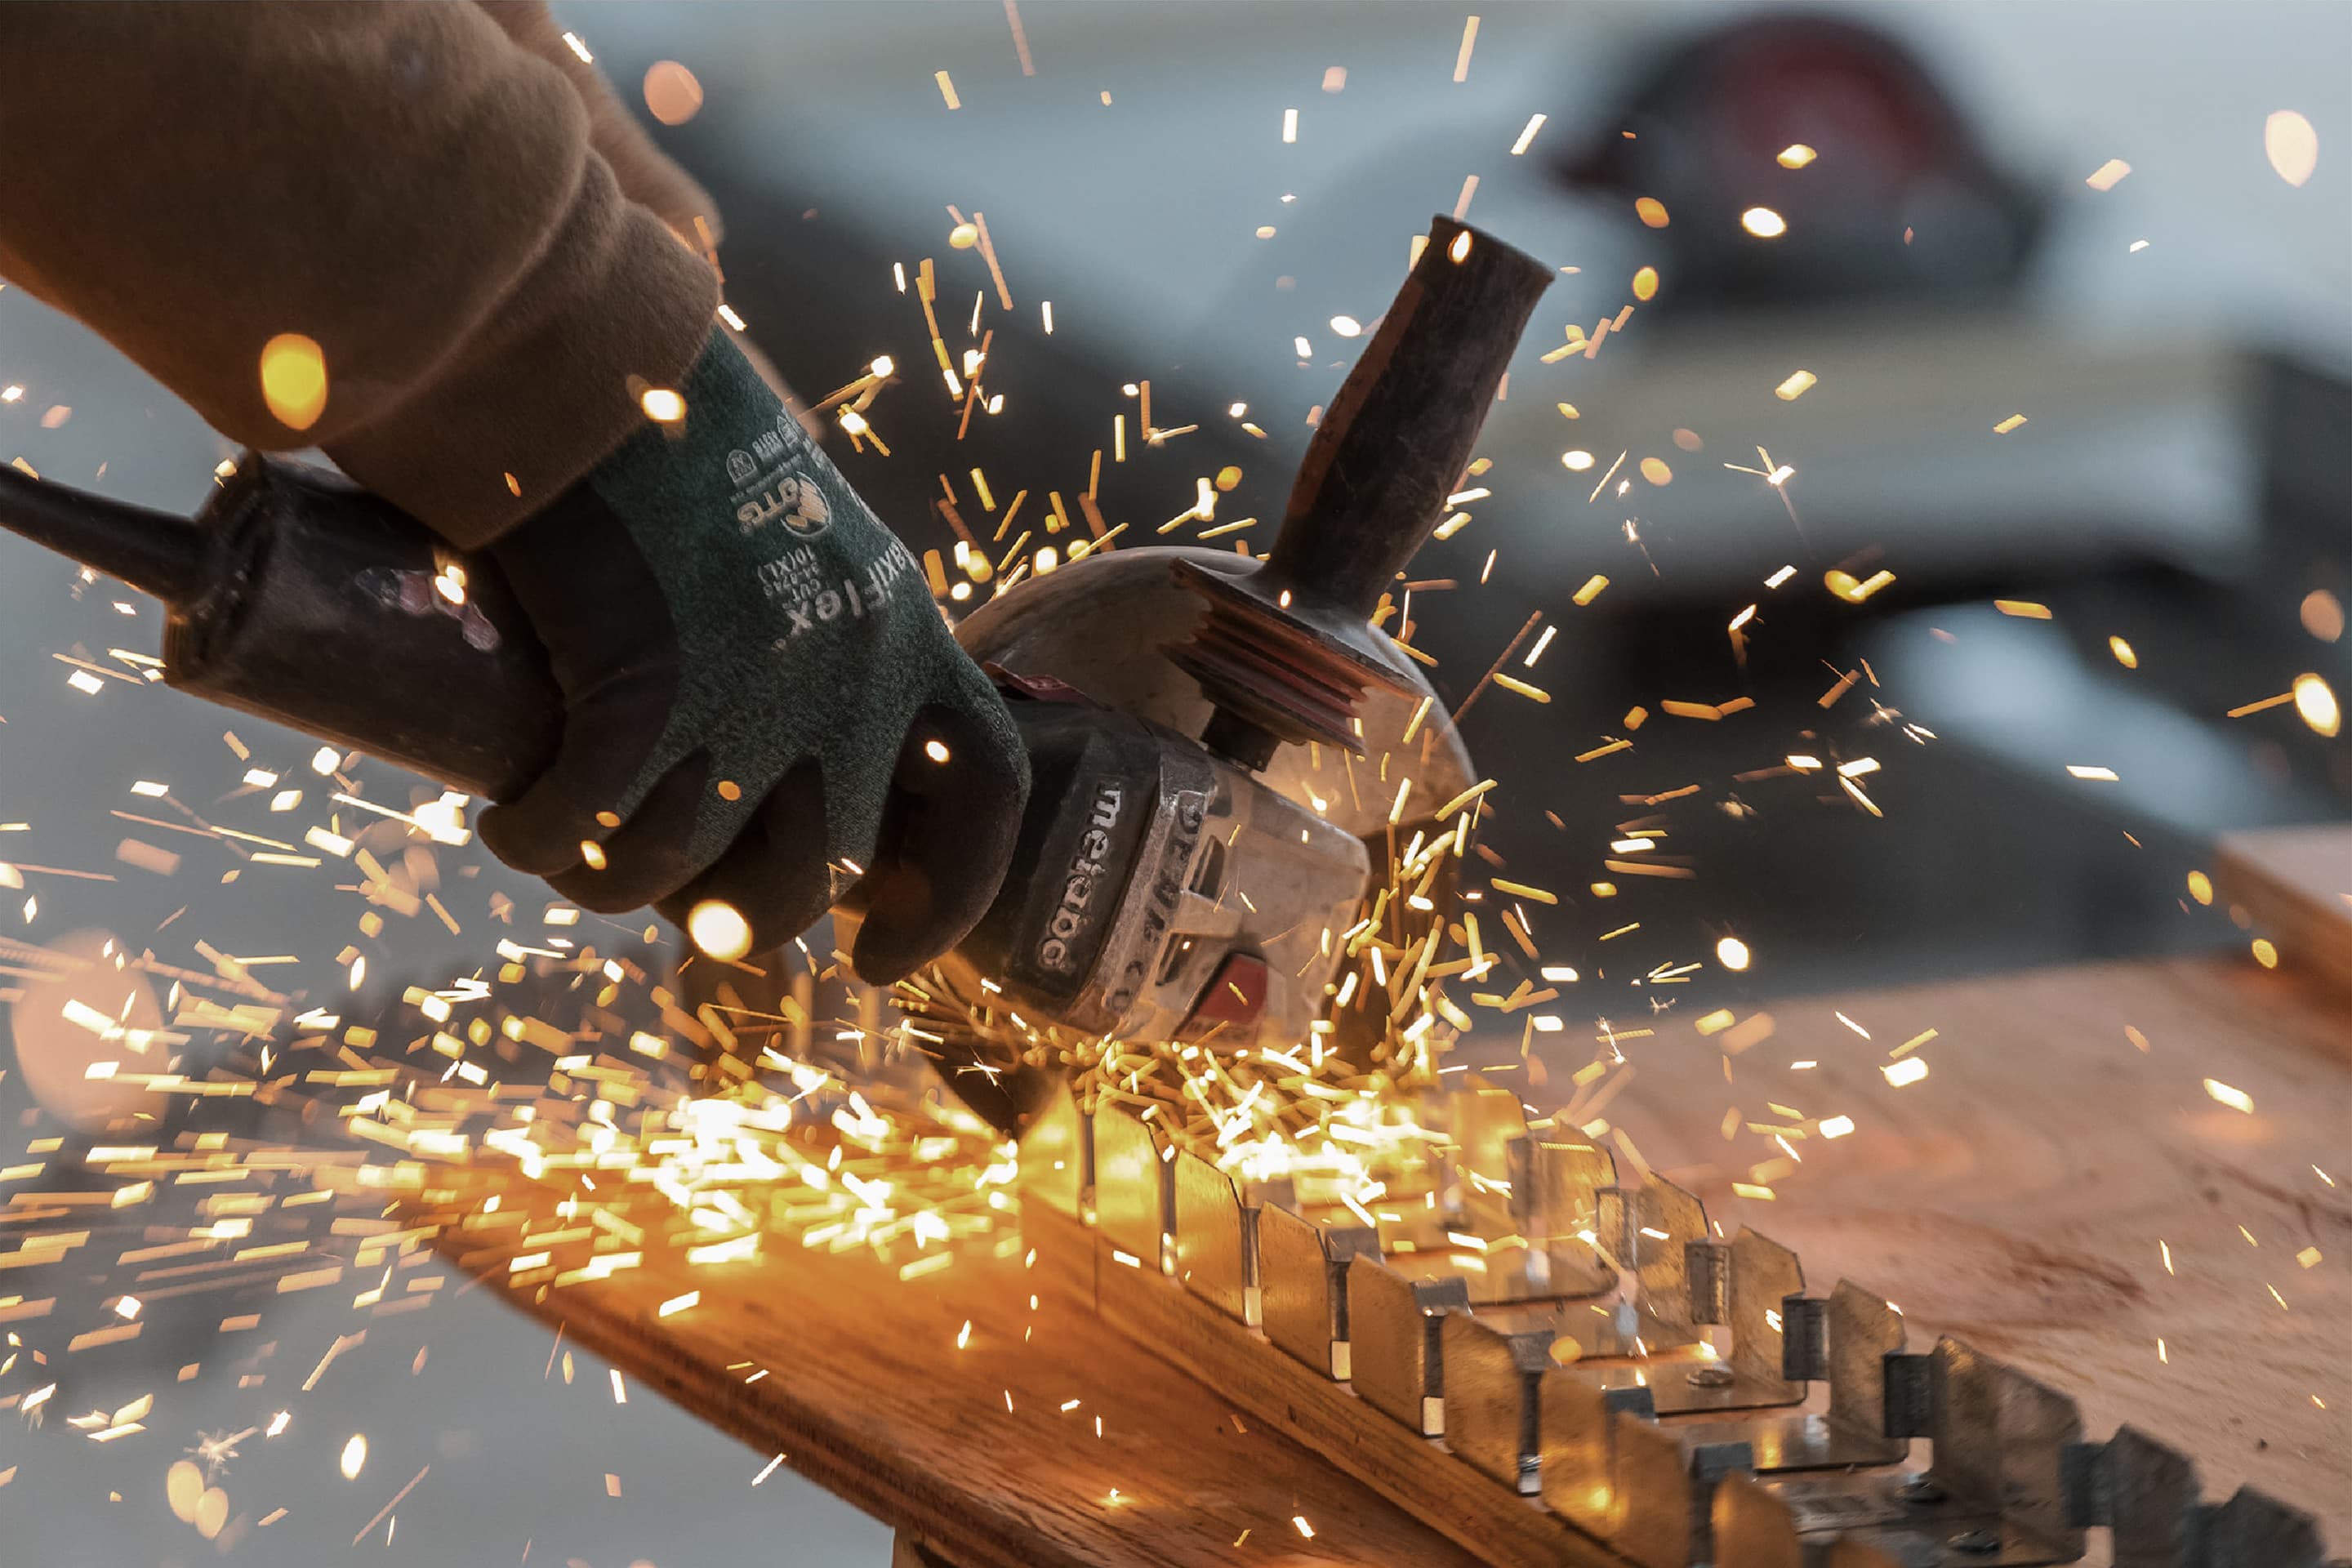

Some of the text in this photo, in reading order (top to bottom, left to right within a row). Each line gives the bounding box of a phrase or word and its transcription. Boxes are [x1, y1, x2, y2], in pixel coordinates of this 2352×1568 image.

[758, 544, 817, 585] 10(XL)
[791, 578, 822, 602] CUT
[1040, 782, 1123, 969] metabo
